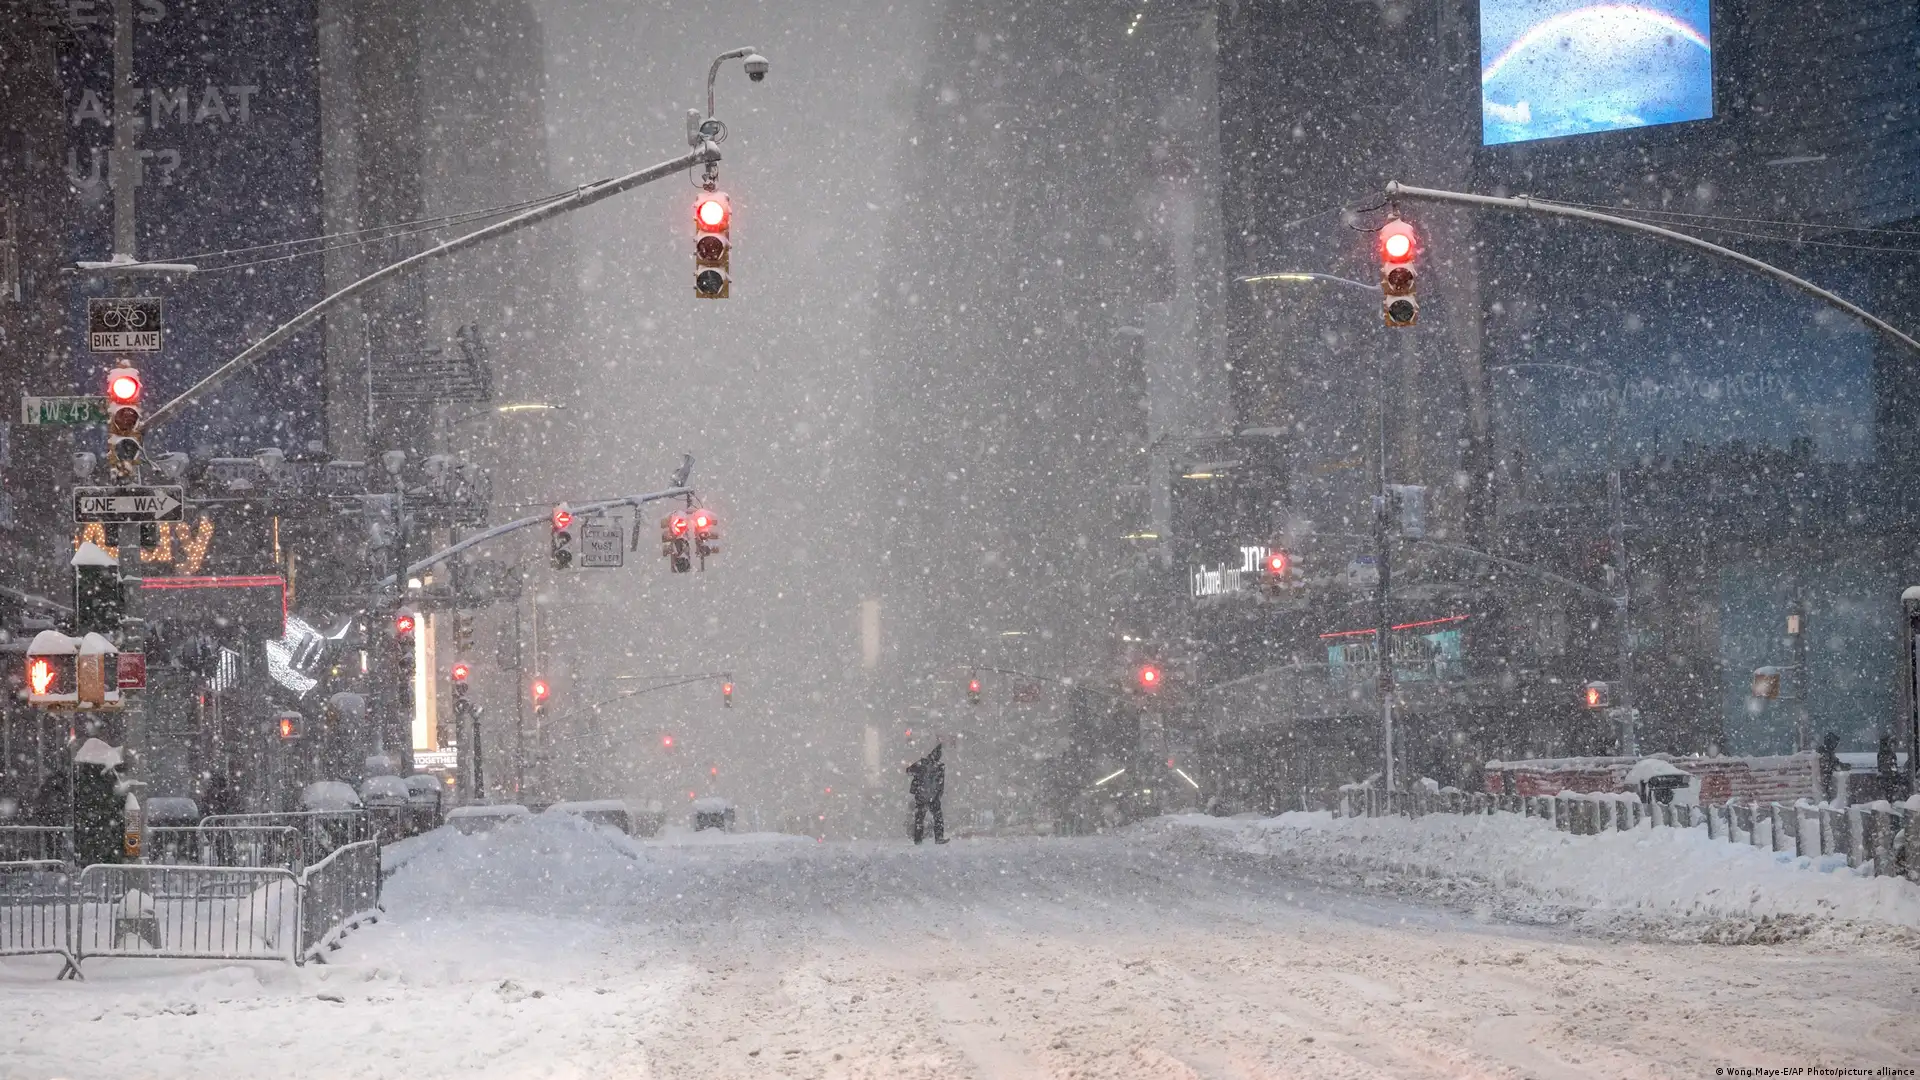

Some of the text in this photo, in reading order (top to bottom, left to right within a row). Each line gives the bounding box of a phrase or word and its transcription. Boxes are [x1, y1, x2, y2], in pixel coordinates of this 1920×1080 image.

[93, 333, 157, 347] BIKE LANE
[44, 400, 90, 421] W 43
[84, 497, 168, 512] ONE WAY
[414, 756, 457, 765] TOGETHER
